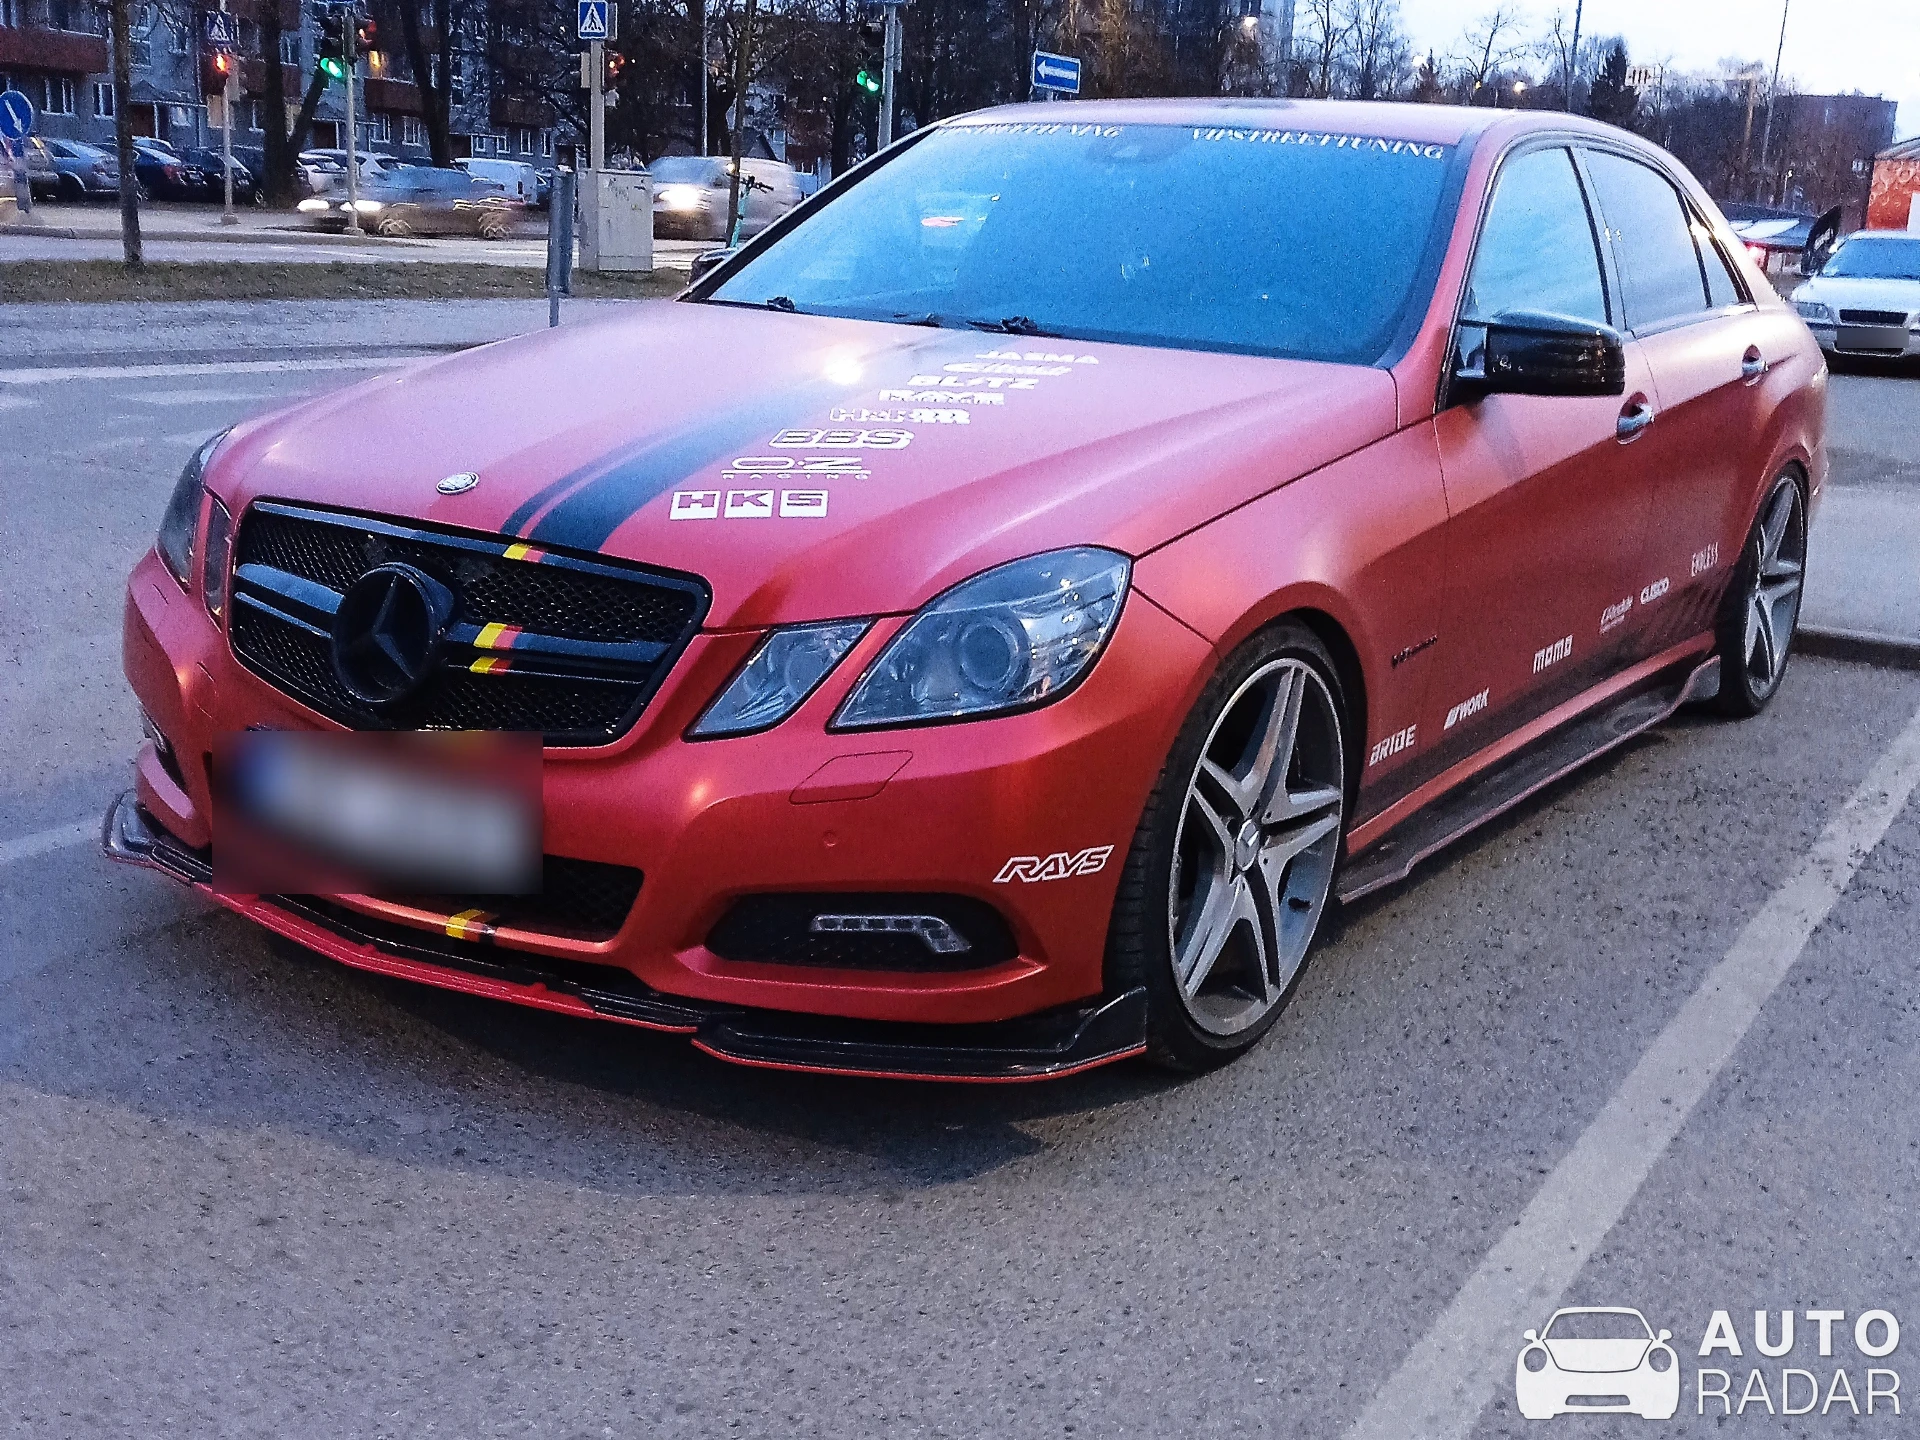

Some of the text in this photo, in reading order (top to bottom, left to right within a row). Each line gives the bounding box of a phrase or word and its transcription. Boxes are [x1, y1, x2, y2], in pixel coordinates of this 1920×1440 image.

[768, 427, 915, 450] BBS
[671, 490, 828, 517] HKS
[1456, 686, 1490, 723] WORK
[992, 844, 1115, 883] RAYS
